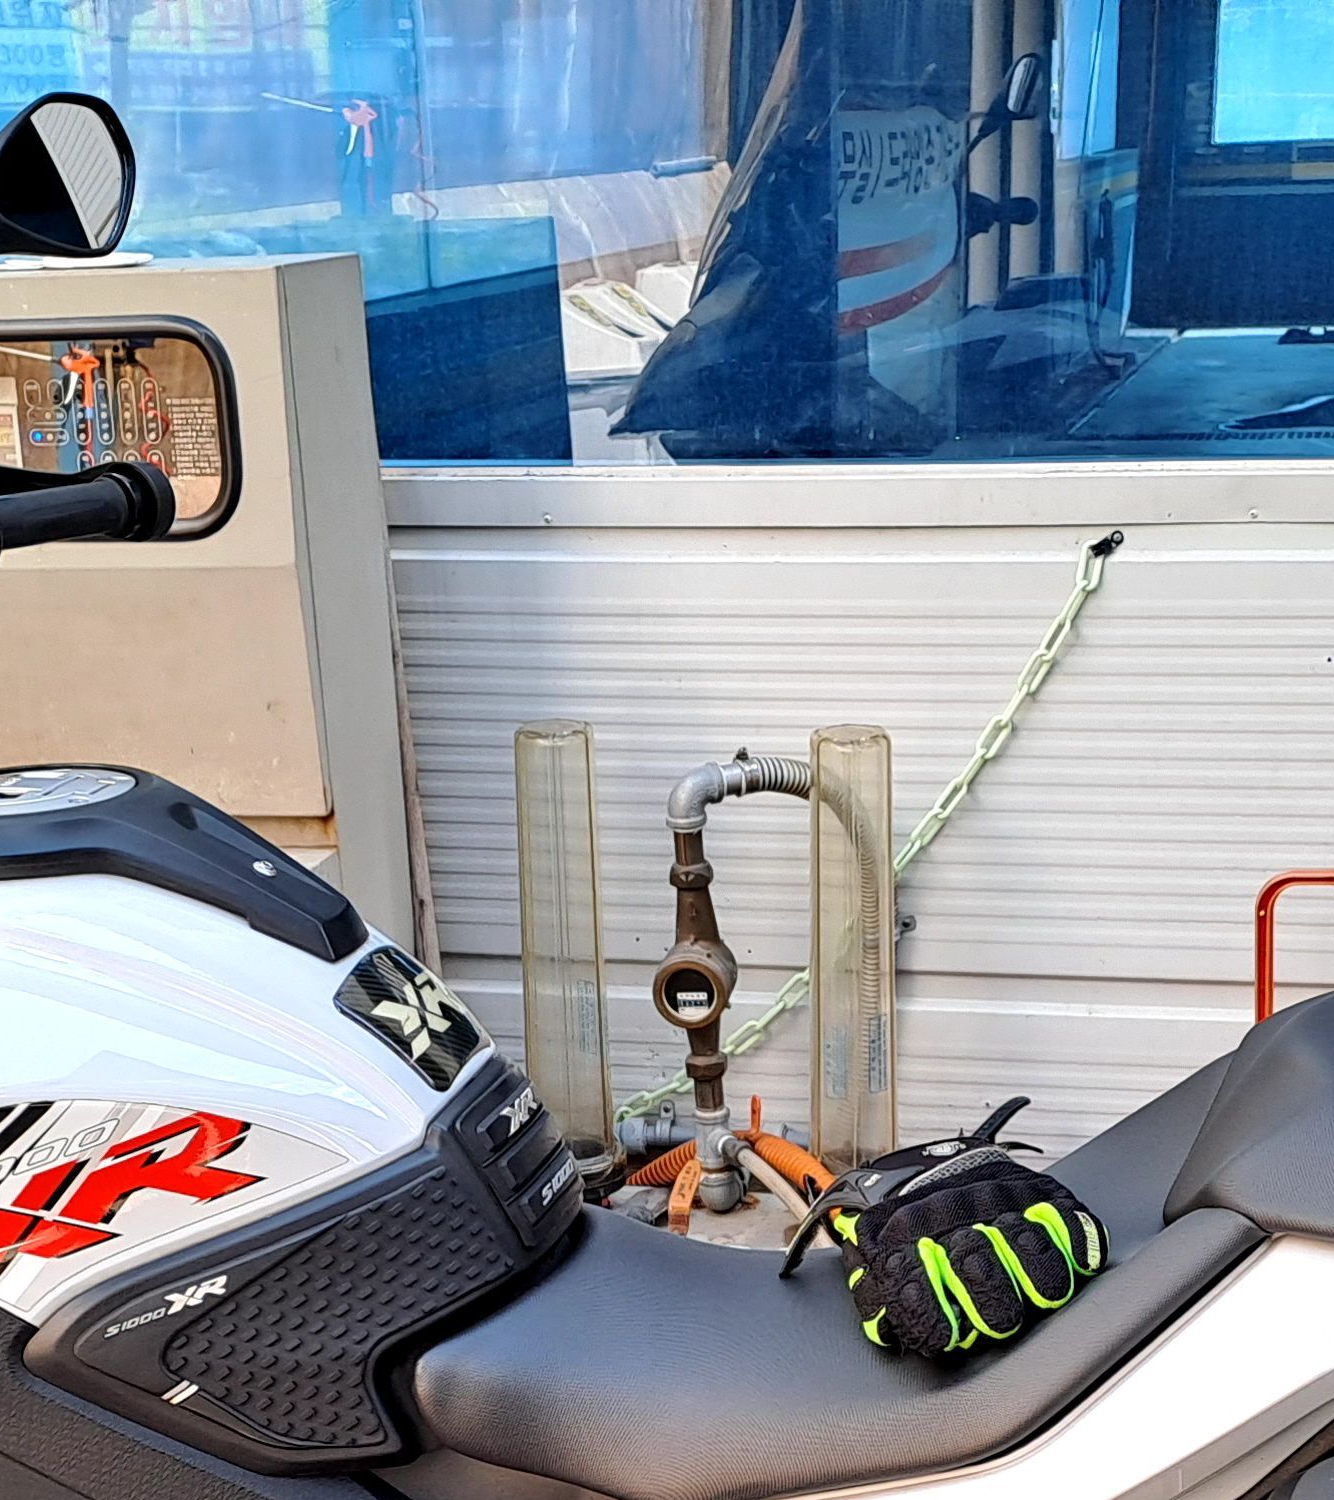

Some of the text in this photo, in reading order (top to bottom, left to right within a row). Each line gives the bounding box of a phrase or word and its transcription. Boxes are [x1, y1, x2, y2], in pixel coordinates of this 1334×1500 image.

[500, 1086, 539, 1138] XR
[541, 1157, 575, 1207] S1000
[104, 1274, 228, 1339] S1000 XR
